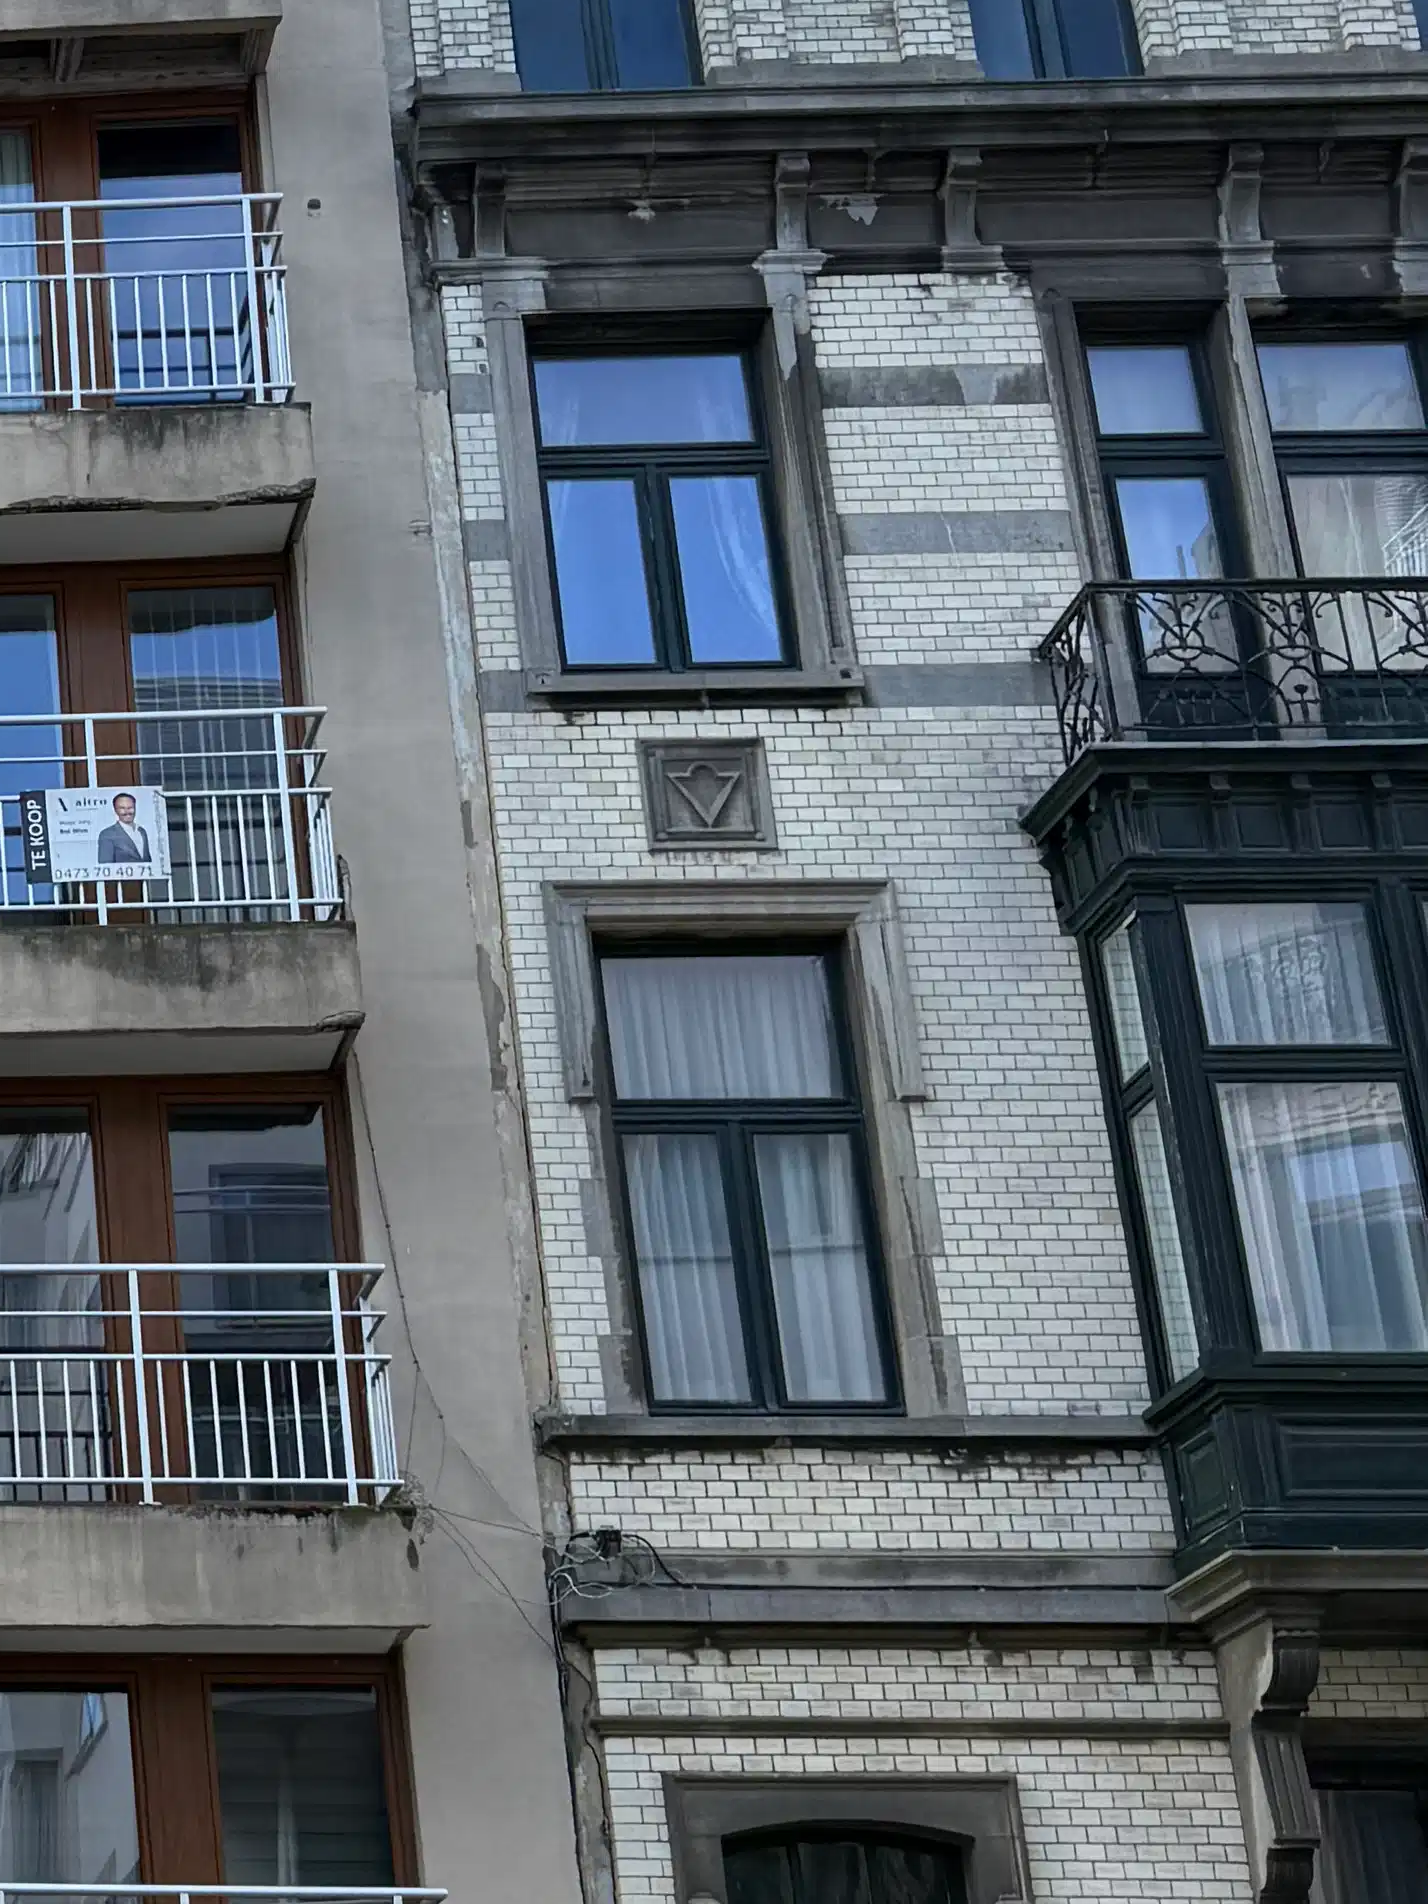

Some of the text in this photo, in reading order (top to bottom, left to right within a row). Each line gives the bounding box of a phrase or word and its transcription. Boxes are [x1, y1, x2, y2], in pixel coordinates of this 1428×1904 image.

[26, 799, 47, 871] TE KOOP
[54, 867, 90, 880] 0473
[94, 866, 111, 878] 70
[115, 866, 134, 877] 40
